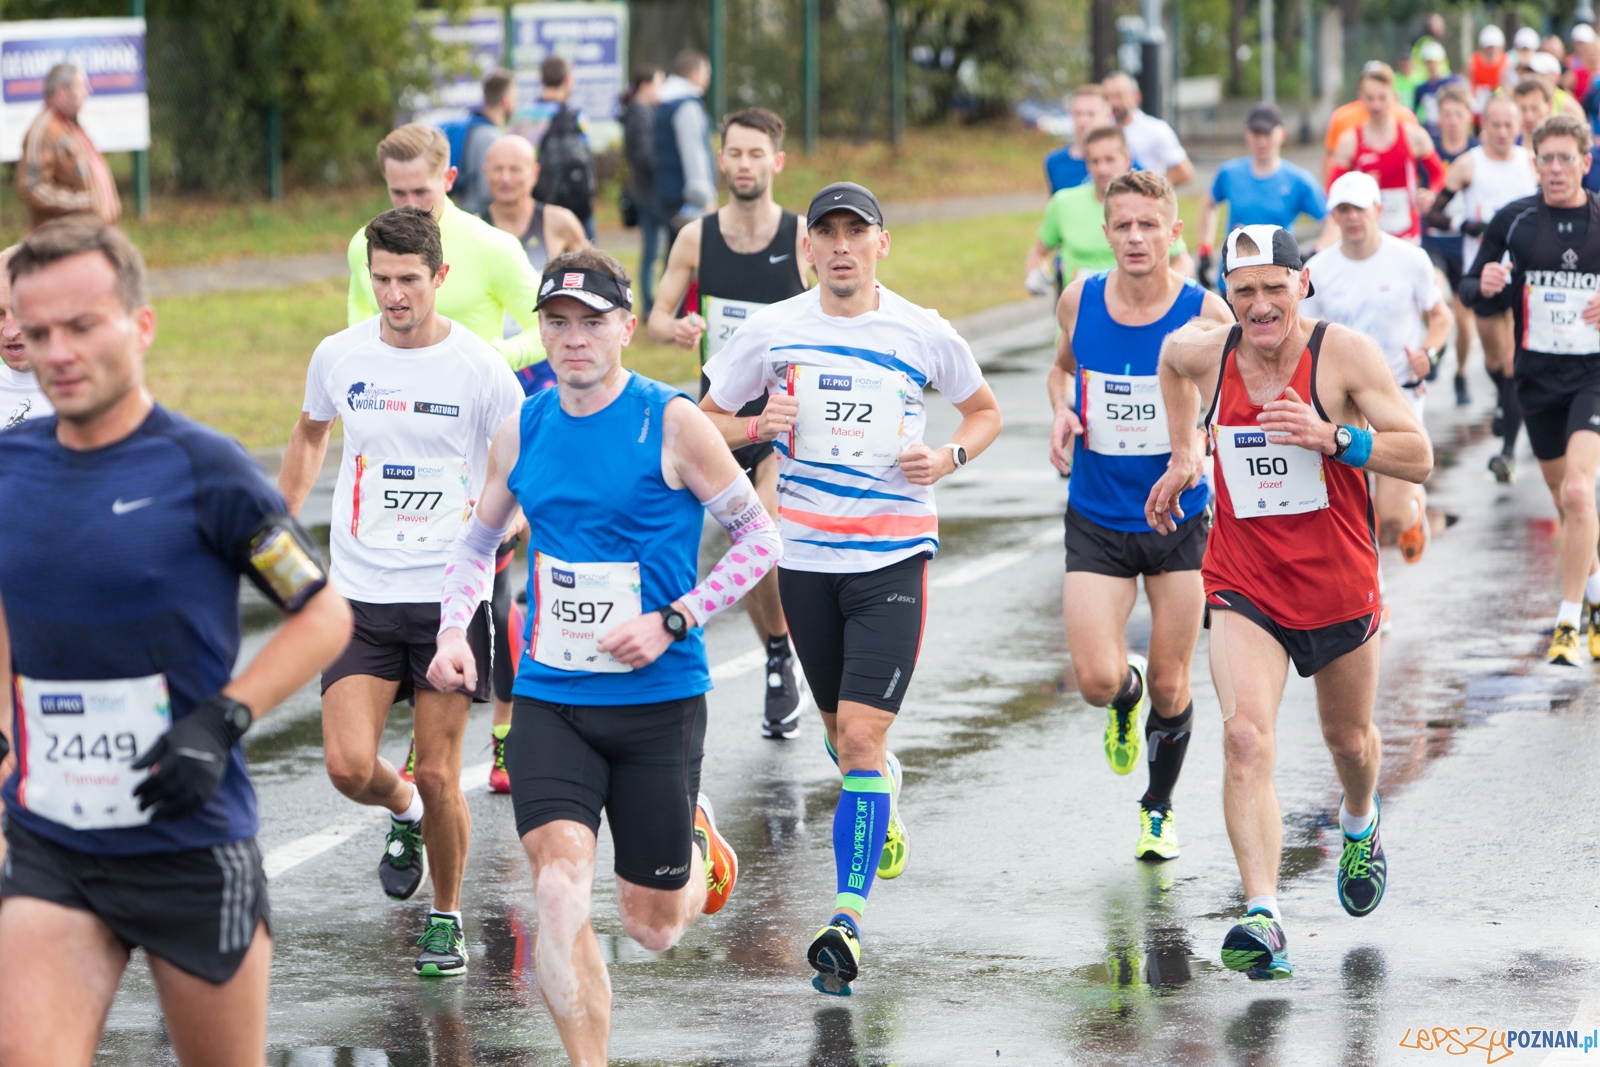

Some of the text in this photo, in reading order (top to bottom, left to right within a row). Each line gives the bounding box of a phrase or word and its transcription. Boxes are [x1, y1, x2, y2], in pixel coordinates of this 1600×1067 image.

[429, 404, 458, 415] SATURN
[825, 401, 872, 423] 372
[1107, 403, 1155, 420] 5219
[831, 427, 865, 438] Maciej
[1246, 457, 1288, 476] 160
[1258, 481, 1283, 489] Józef
[384, 490, 443, 510] 5777
[397, 514, 428, 523] Paweł
[897, 595, 915, 604] asics
[551, 598, 614, 623] 4597
[562, 628, 594, 639] Paweł
[46, 732, 137, 763] 2449
